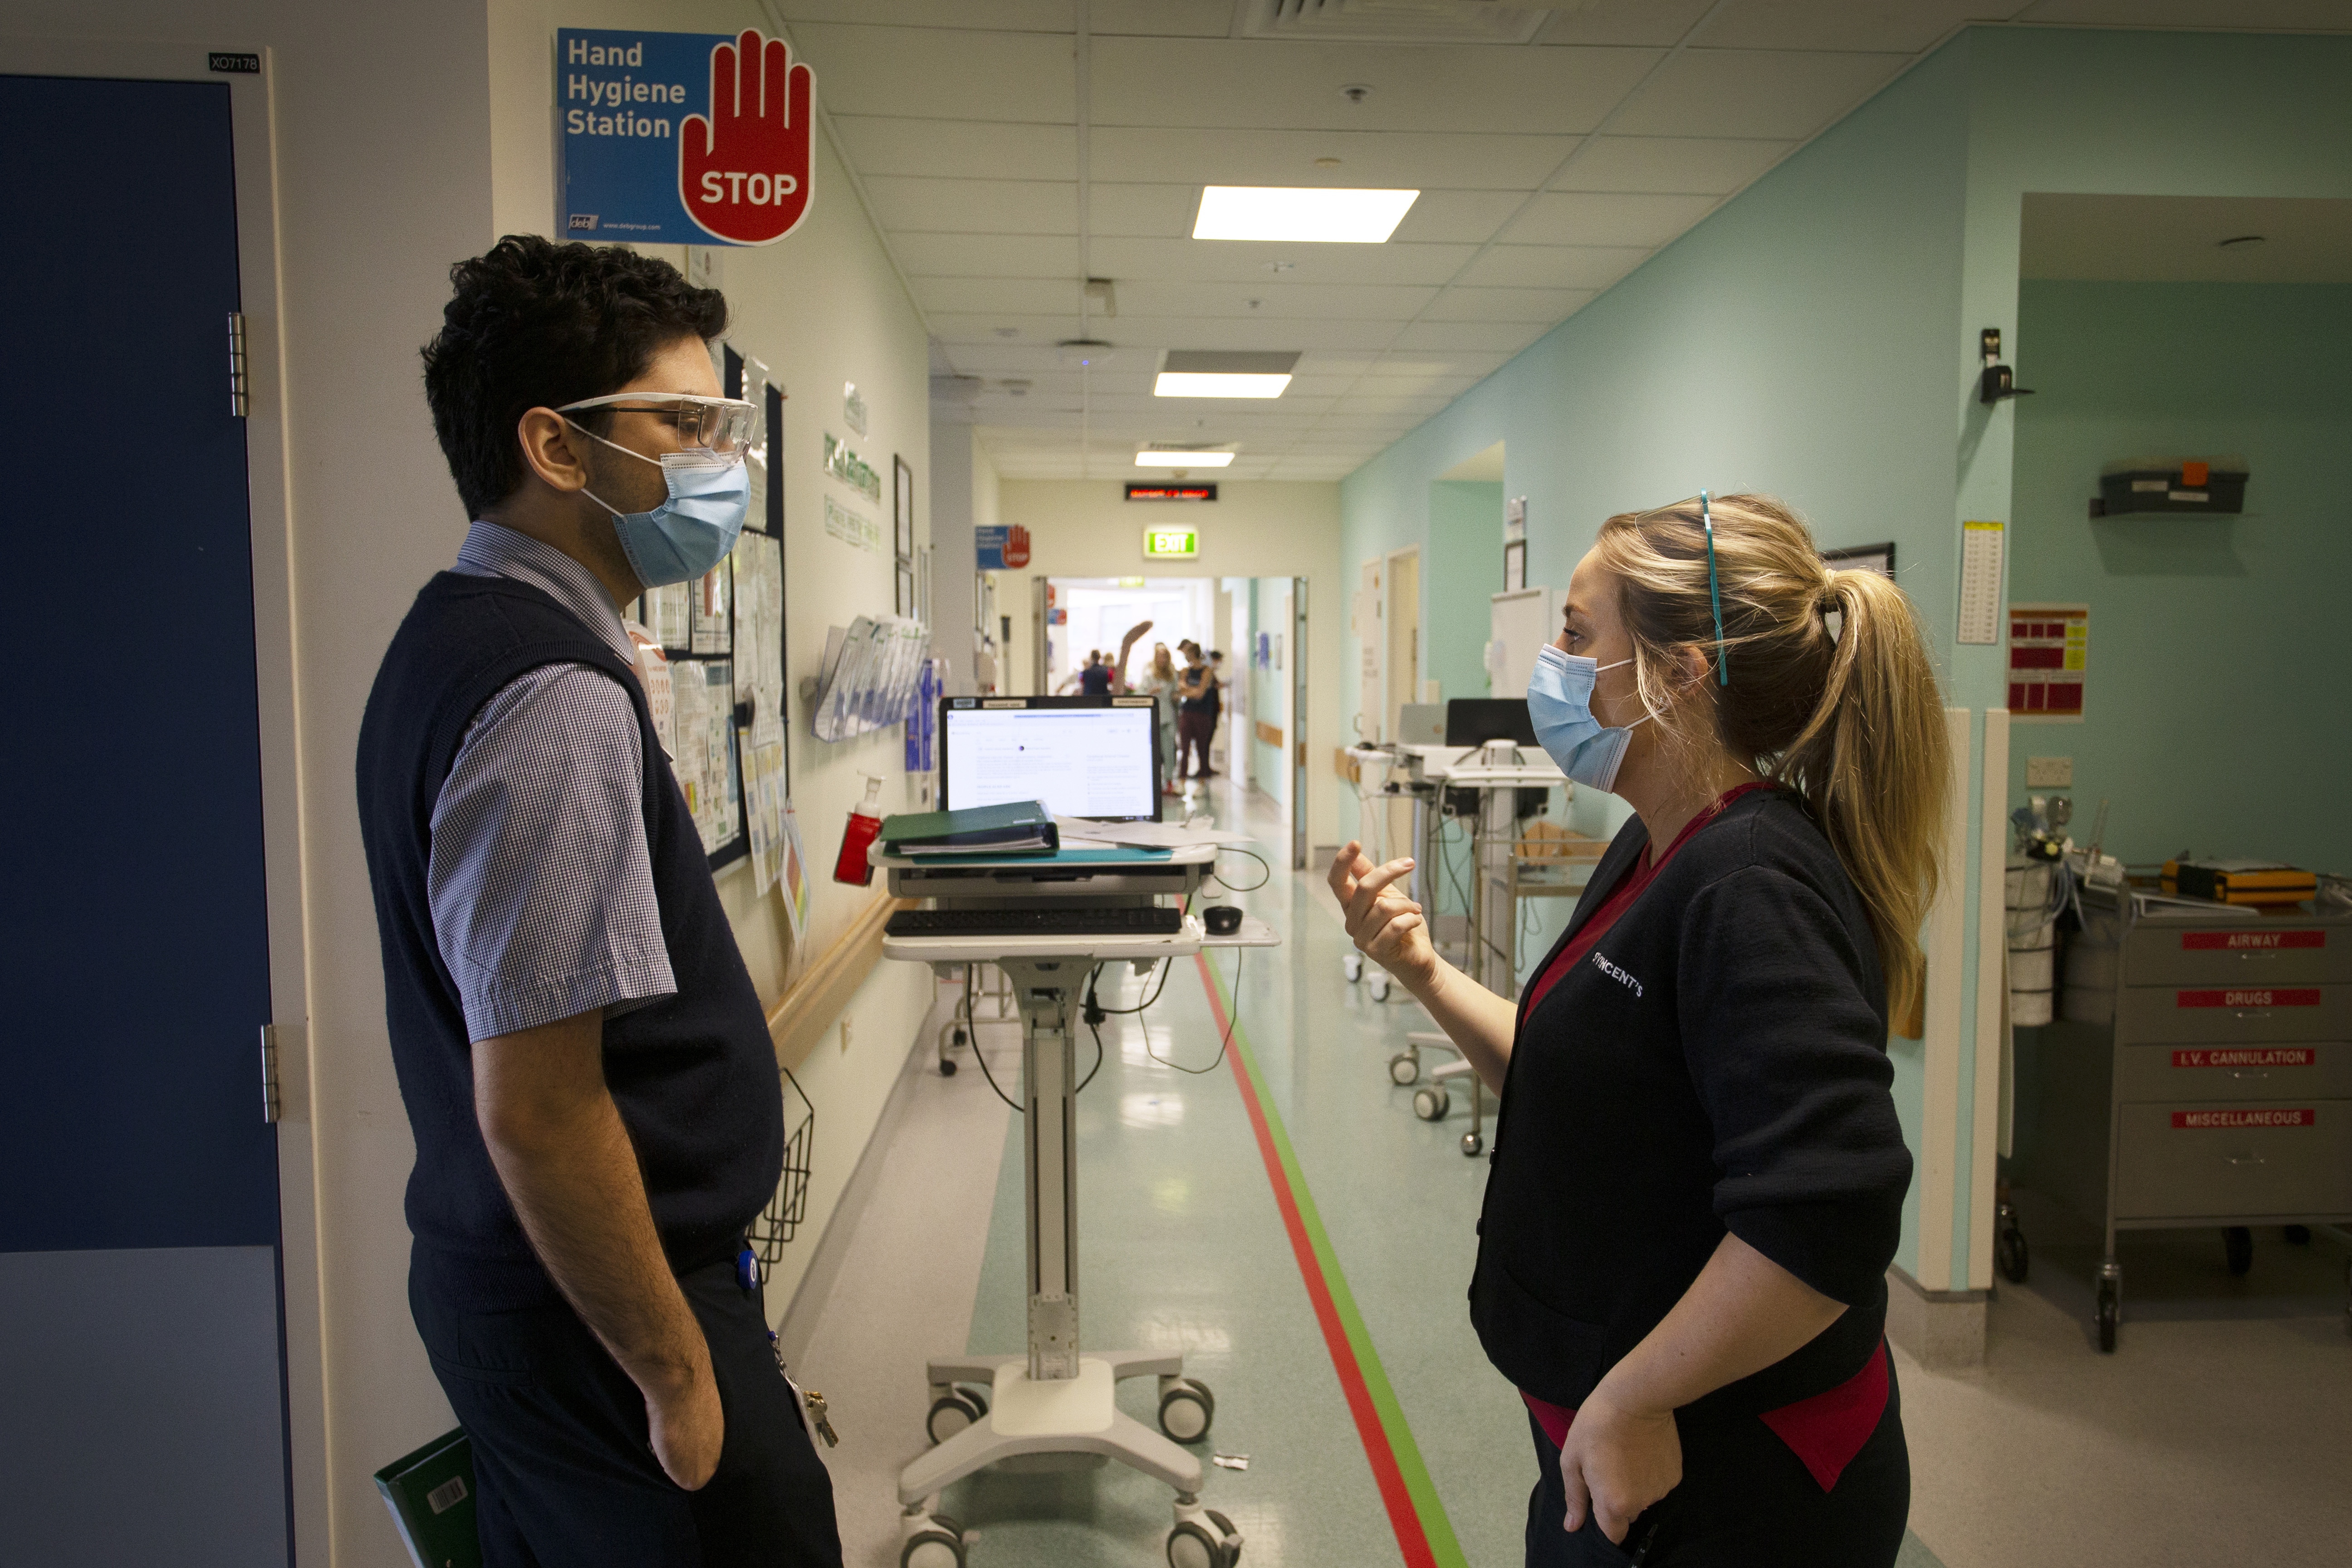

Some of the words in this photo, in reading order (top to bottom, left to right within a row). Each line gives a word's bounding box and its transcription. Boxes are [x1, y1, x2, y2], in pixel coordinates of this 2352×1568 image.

[568, 39, 642, 67] Hand
[568, 74, 686, 107] Hygiene
[567, 109, 671, 137] Station
[701, 171, 798, 206] STOP
[571, 218, 589, 228] deb
[1155, 534, 1189, 552] EXIT
[2228, 934, 2281, 947] AIRWAY
[2225, 991, 2272, 1005] DRUGS
[2210, 1050, 2307, 1065] CANNULATION
[2185, 1111, 2302, 1127] MISCELLANEOUS
